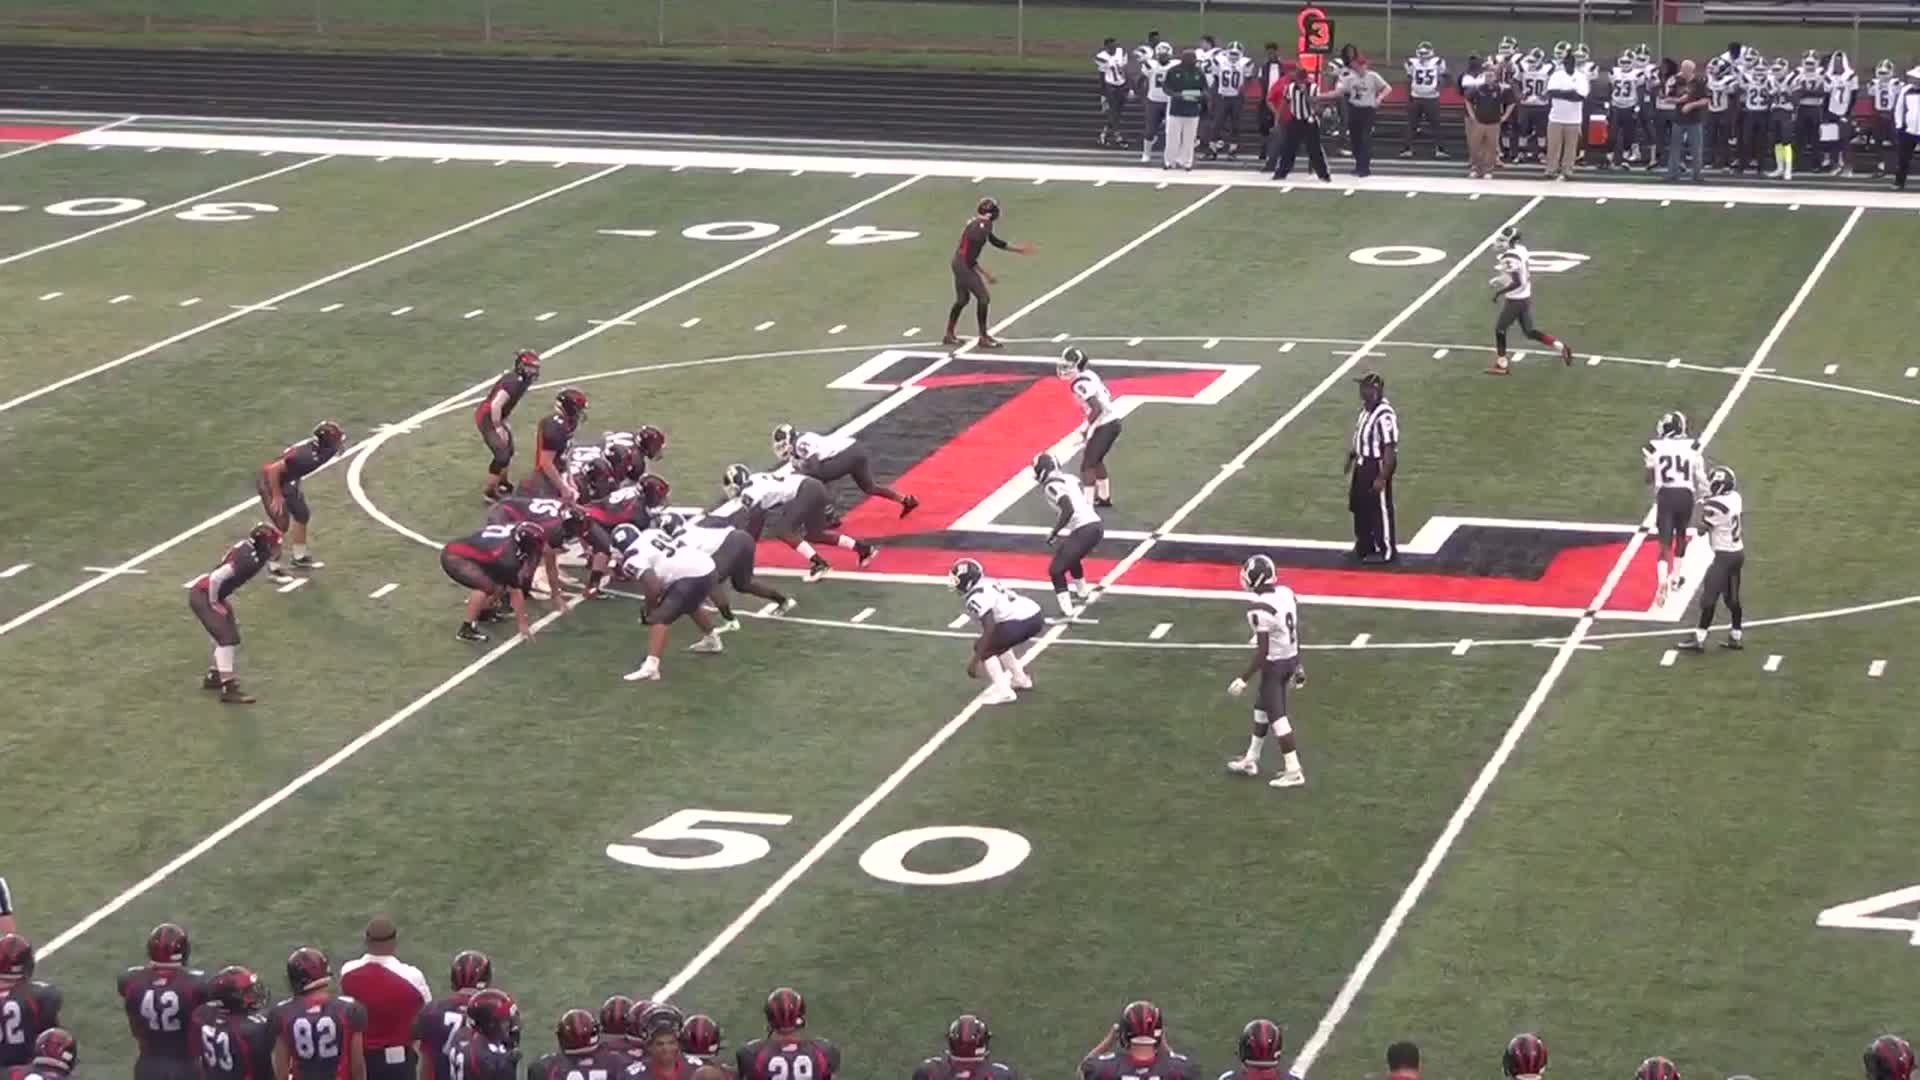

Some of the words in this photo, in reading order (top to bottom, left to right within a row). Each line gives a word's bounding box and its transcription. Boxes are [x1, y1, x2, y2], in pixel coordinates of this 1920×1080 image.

[1221, 71, 1240, 88] 60
[1525, 79, 1544, 97] 50
[1613, 80, 1632, 98] 53
[1658, 455, 1690, 484] 24
[0, 1001, 25, 1045] 2
[140, 989, 181, 1032] 42
[201, 1025, 234, 1072] 53
[293, 1016, 338, 1059] 82
